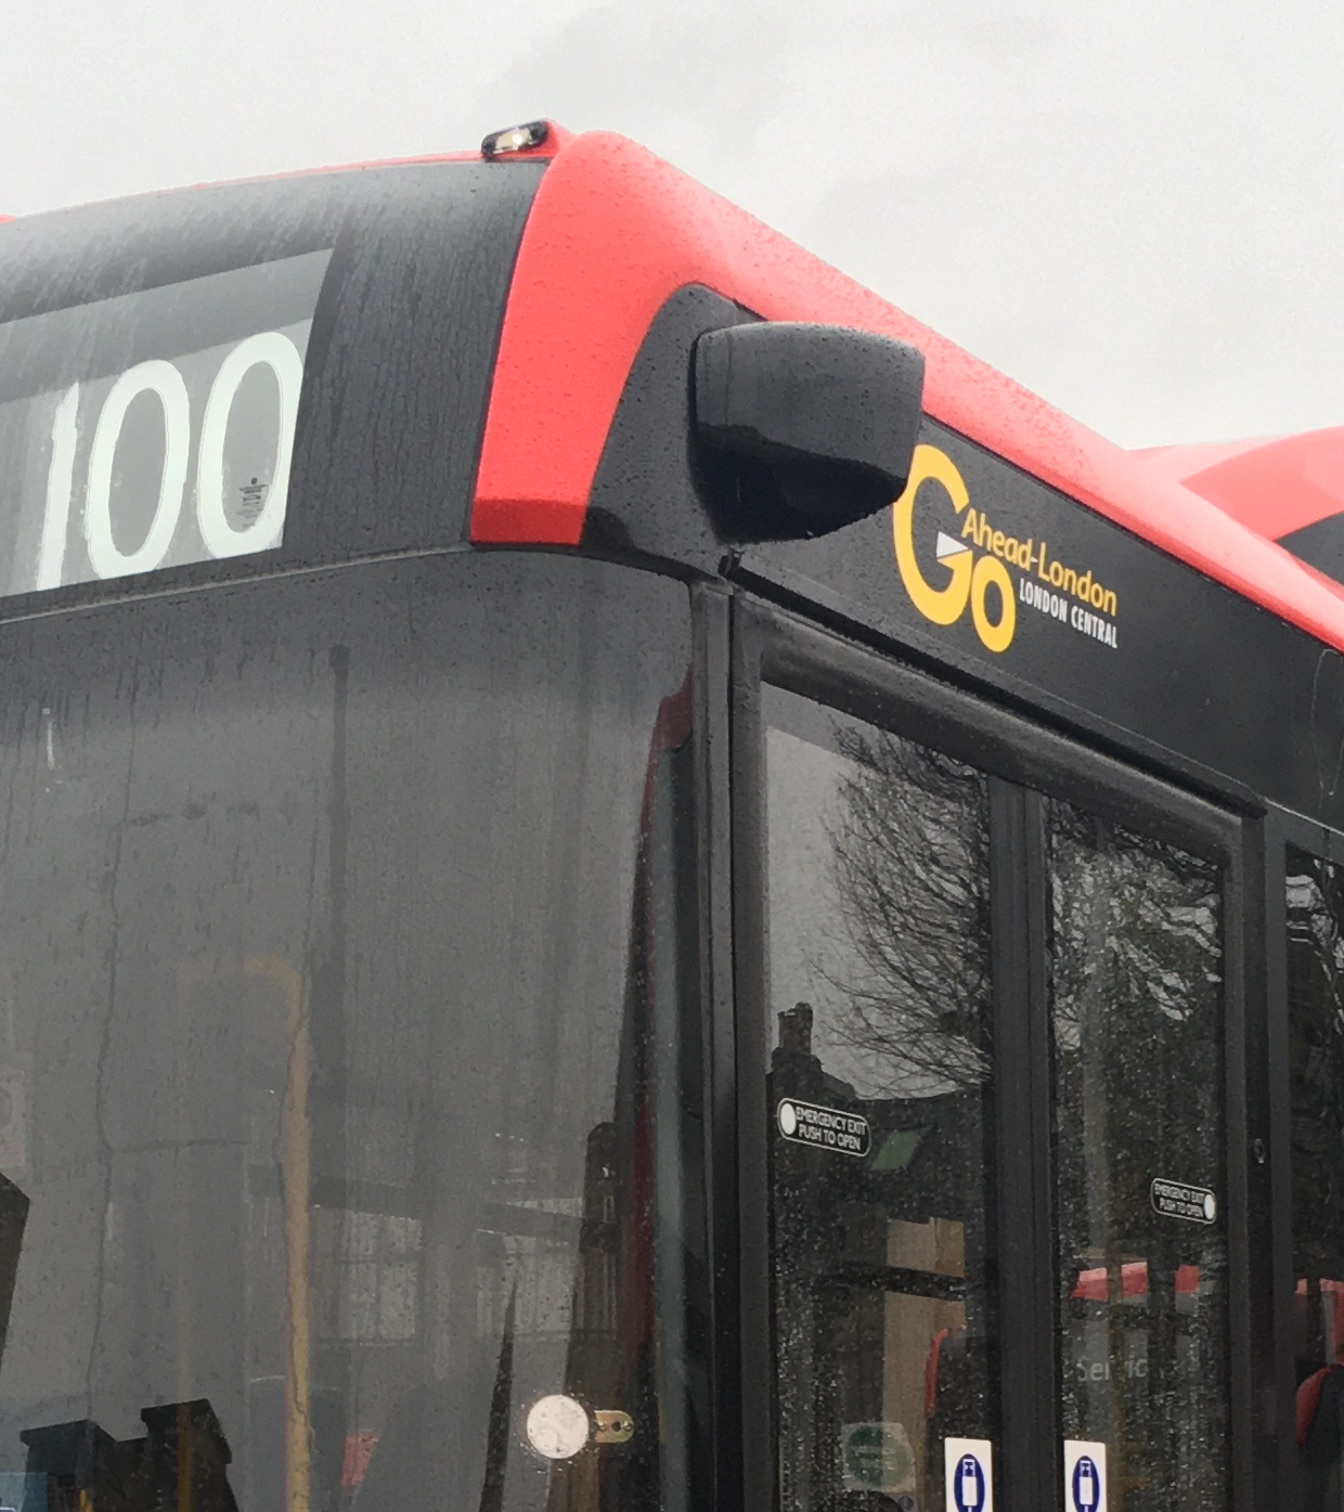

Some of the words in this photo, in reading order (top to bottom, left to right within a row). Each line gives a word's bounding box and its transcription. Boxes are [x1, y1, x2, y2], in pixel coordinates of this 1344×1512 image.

[37, 331, 303, 590] 100
[892, 443, 1017, 653] Go
[1019, 577, 1068, 624] LONDON
[1070, 604, 1118, 649] CENTRAL
[796, 1106, 846, 1131] EMERGENCY
[847, 1119, 866, 1135] EXIT
[799, 1123, 822, 1141] PUSH
[823, 1129, 836, 1145] TO
[837, 1132, 861, 1150] OPEN
